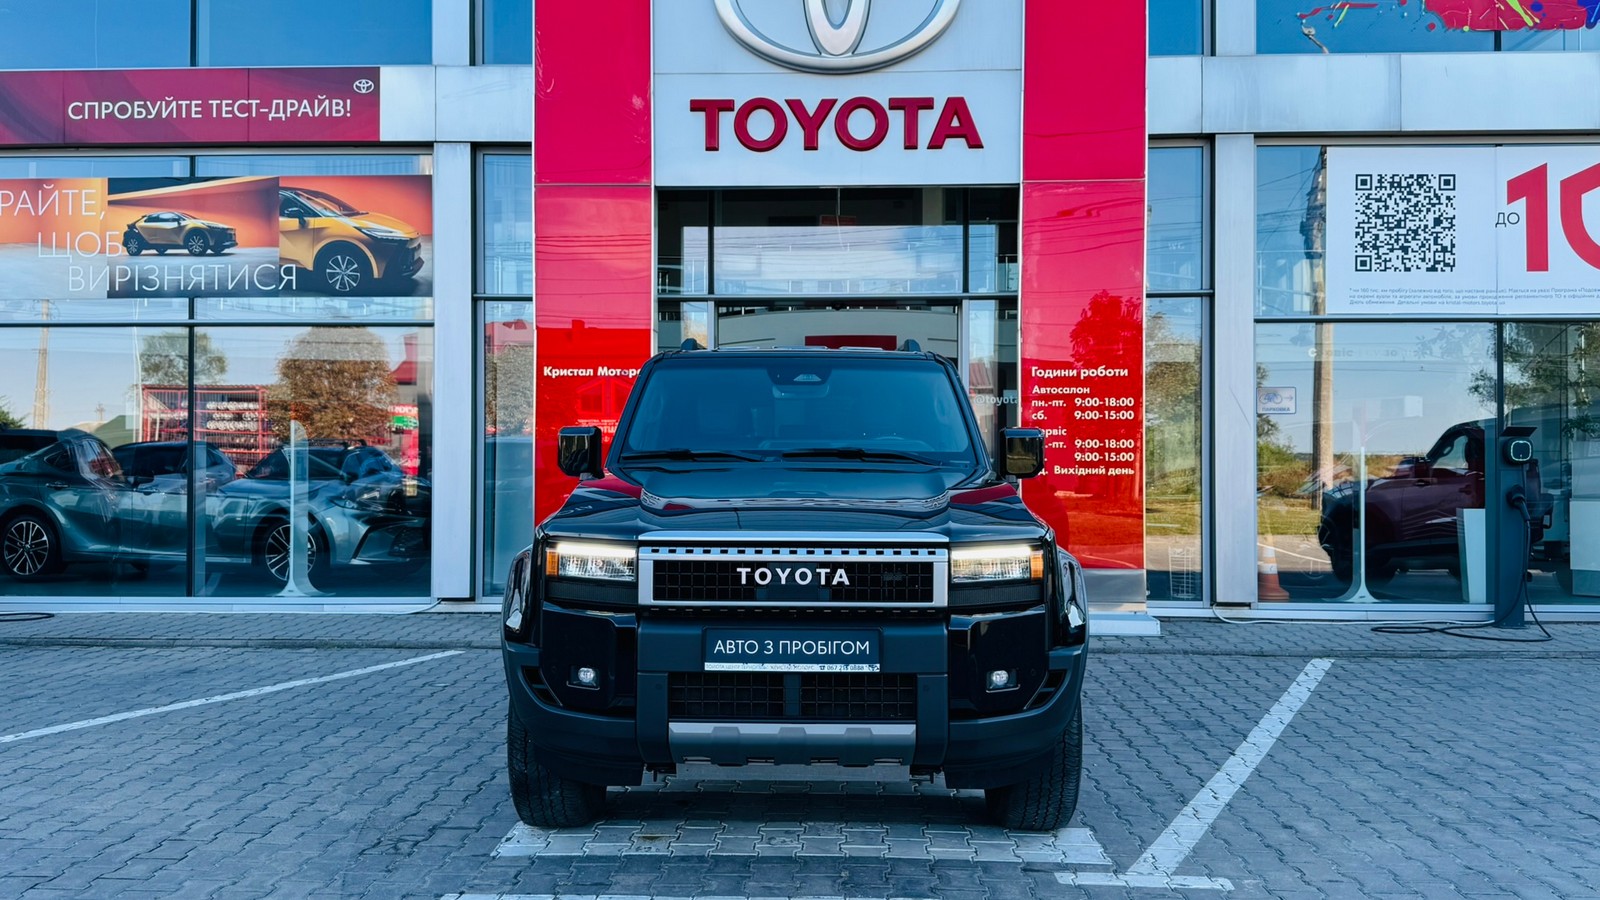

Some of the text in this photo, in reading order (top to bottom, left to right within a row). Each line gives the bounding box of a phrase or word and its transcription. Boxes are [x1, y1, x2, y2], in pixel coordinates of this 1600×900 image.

[68, 94, 352, 120] СПРОБУЙТЕ ТЕСТ-ДРАЙВ!
[690, 97, 984, 152] TOYOTA
[0, 184, 106, 220] РАЙТЕ,
[1495, 211, 1520, 228] ДО
[37, 231, 122, 262] ЩОБ
[68, 264, 297, 293] ВИРІЗНЯТИСЯ
[543, 366, 594, 378] Кристал
[1031, 365, 1129, 379] Години роботи
[1032, 385, 1091, 394] Автосалон
[1074, 397, 1135, 407] 9:00-18:00
[1031, 410, 1135, 420] сб. 9:00-15:00
[1036, 426, 1067, 438] рвіс
[1074, 439, 1135, 449] 9:00-18:00
[1074, 452, 1135, 462] 9:00-15:00
[1054, 465, 1106, 475] Вихідний
[1107, 467, 1135, 475] день
[737, 567, 850, 586] TOYOTA
[713, 640, 759, 654] АВТО
[779, 640, 870, 655] ПРОБІГОМ
